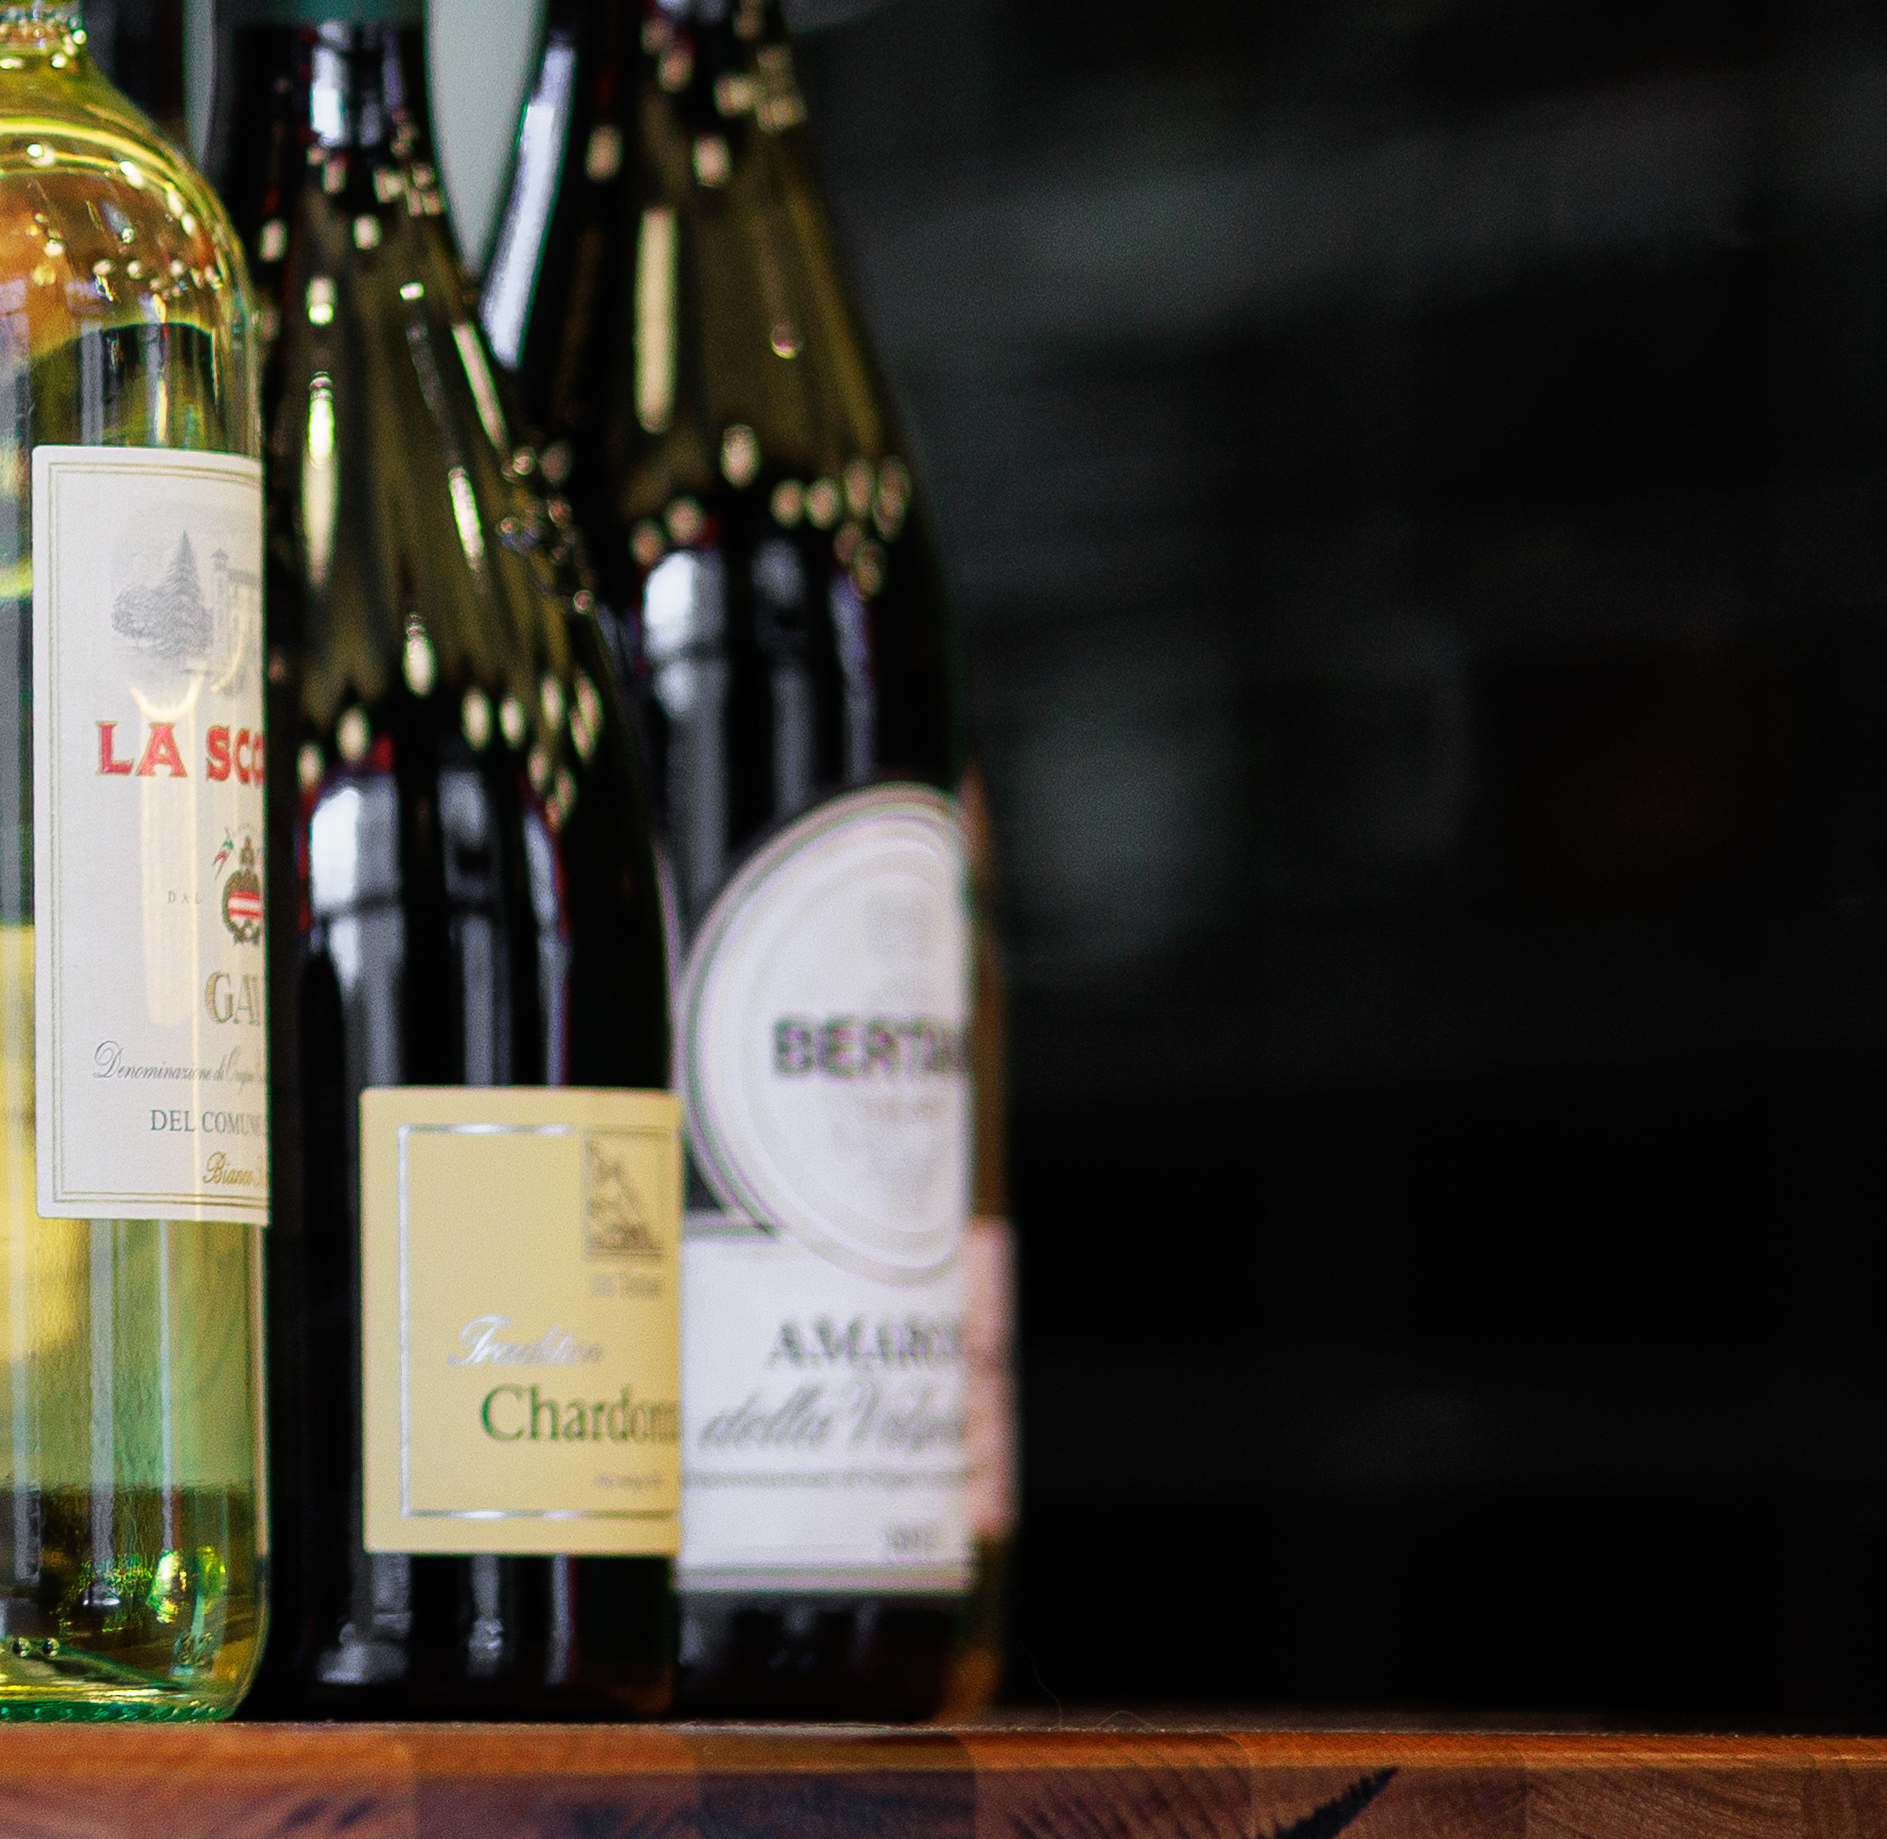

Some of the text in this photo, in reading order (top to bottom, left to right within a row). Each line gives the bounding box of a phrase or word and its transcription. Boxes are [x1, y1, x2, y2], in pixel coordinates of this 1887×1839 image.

[95, 721, 265, 787] LA SCO
[149, 1109, 196, 1132] DEL
